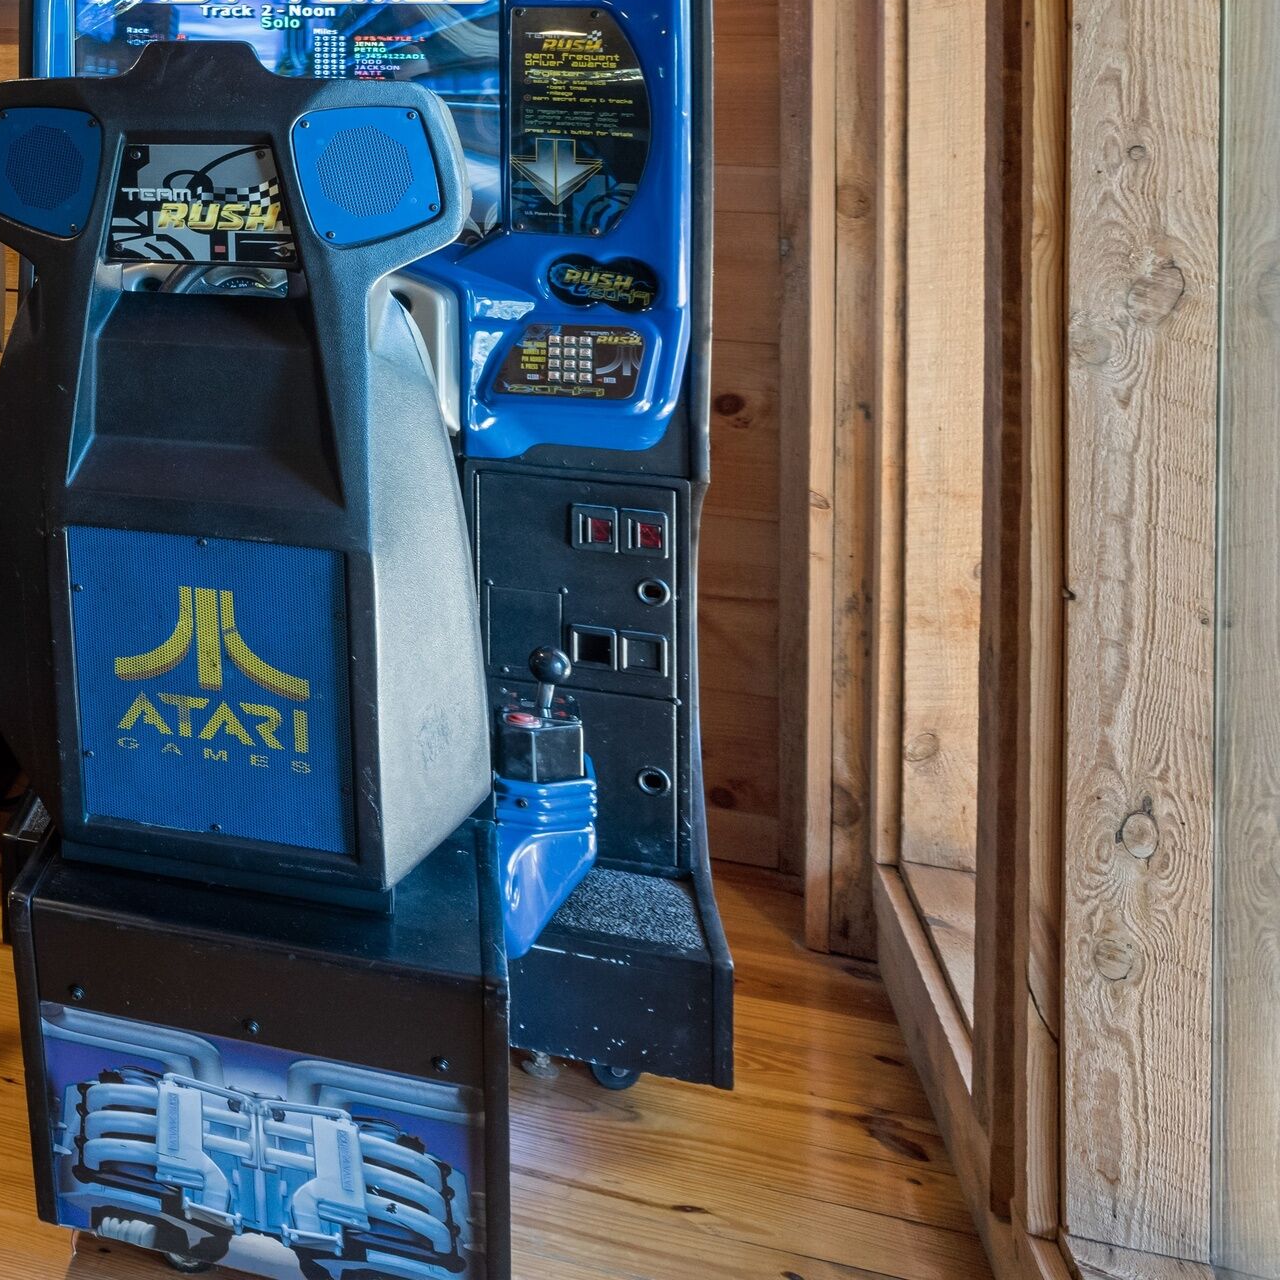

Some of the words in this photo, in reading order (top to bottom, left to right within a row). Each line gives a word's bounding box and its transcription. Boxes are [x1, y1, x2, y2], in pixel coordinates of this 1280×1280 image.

[199, 4, 253, 19] Track
[260, 5, 271, 17] 2
[288, 4, 336, 17] Noon
[259, 16, 301, 30] Solo
[542, 38, 603, 52] RUSH
[561, 53, 620, 62] frequent
[570, 60, 618, 69] awards
[121, 187, 192, 202] TEAM
[157, 202, 282, 232] RUSH
[563, 269, 634, 291] RUSH
[596, 335, 643, 346] RUSH
[117, 690, 310, 754] ATARI
[116, 736, 312, 774] GAMES
